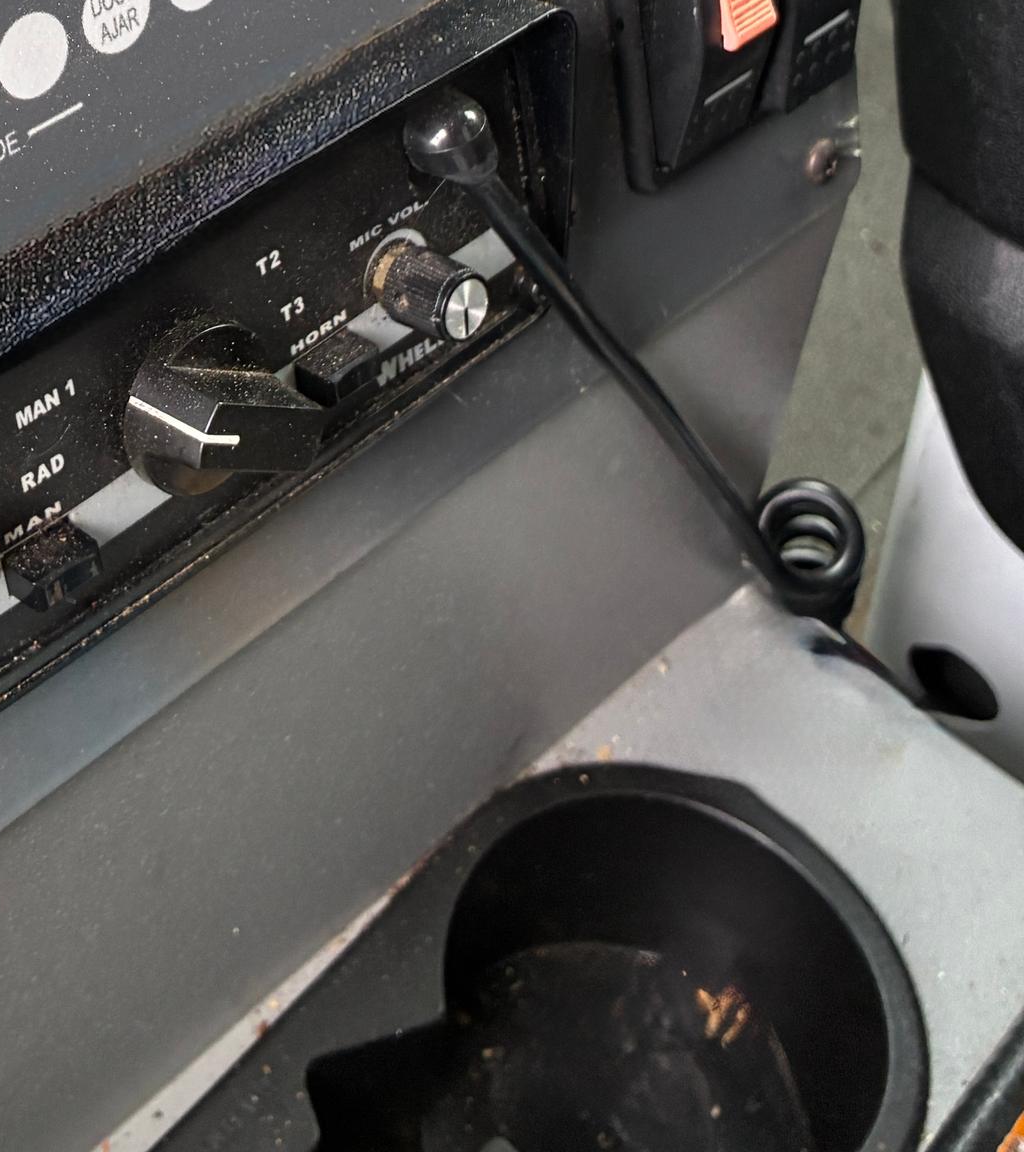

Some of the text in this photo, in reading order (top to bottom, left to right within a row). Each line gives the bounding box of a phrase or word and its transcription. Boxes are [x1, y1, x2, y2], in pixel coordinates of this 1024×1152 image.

[100, 7, 140, 44] AJAR
[349, 224, 383, 252] MIC
[255, 250, 282, 276] T2
[279, 297, 305, 322] T3
[290, 309, 348, 355] HORN
[376, 338, 445, 386] WHEL
[15, 378, 76, 430] MAN 1
[20, 453, 65, 493] RAD
[3, 500, 62, 544] MAN
